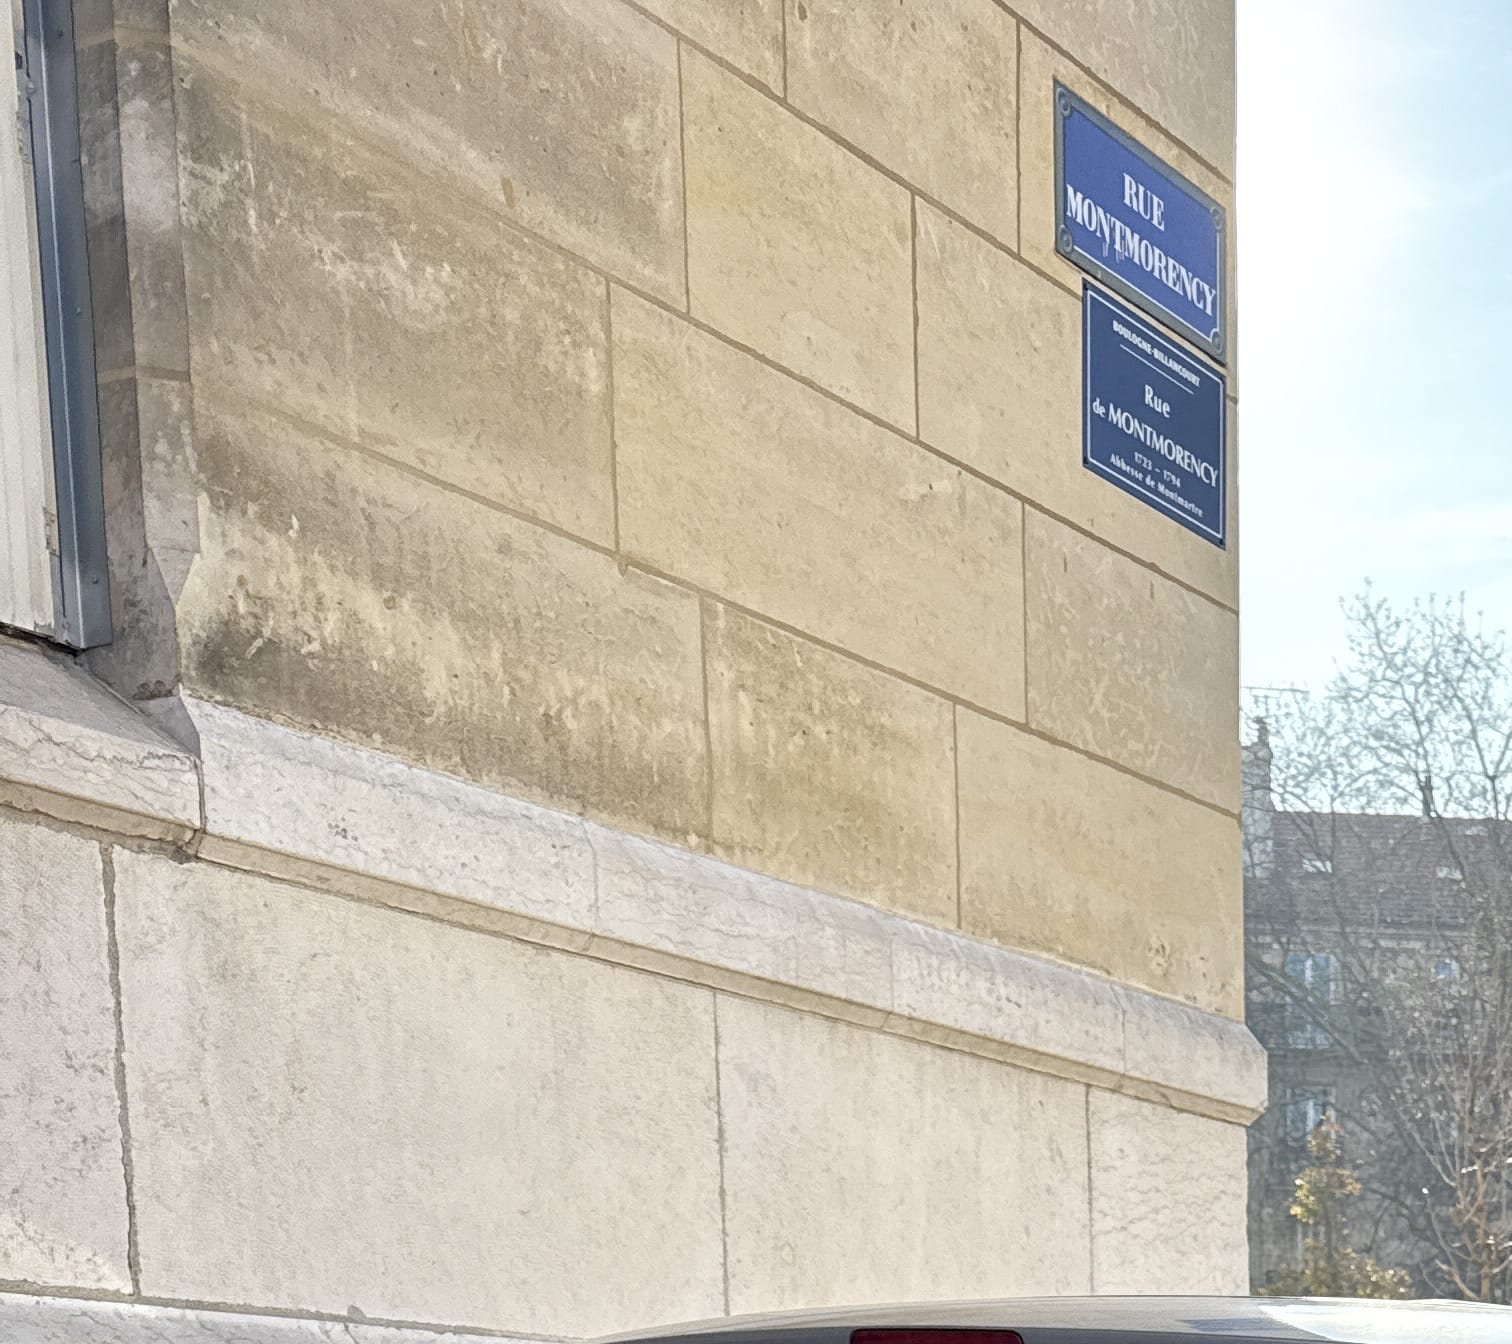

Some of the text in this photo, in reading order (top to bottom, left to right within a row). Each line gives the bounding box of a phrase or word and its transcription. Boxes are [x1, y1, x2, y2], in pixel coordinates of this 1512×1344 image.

[1123, 172, 1165, 231] RUE
[1066, 184, 1217, 317] MONTMORENCY
[1112, 320, 1201, 388] BOULOGNE-BILLANCOURT
[1144, 384, 1171, 418] Rue
[1092, 397, 1218, 488] de MONTMORENCY
[1134, 452, 1153, 471] 1723
[1110, 453, 1203, 518] Abbesse de Montmartre
